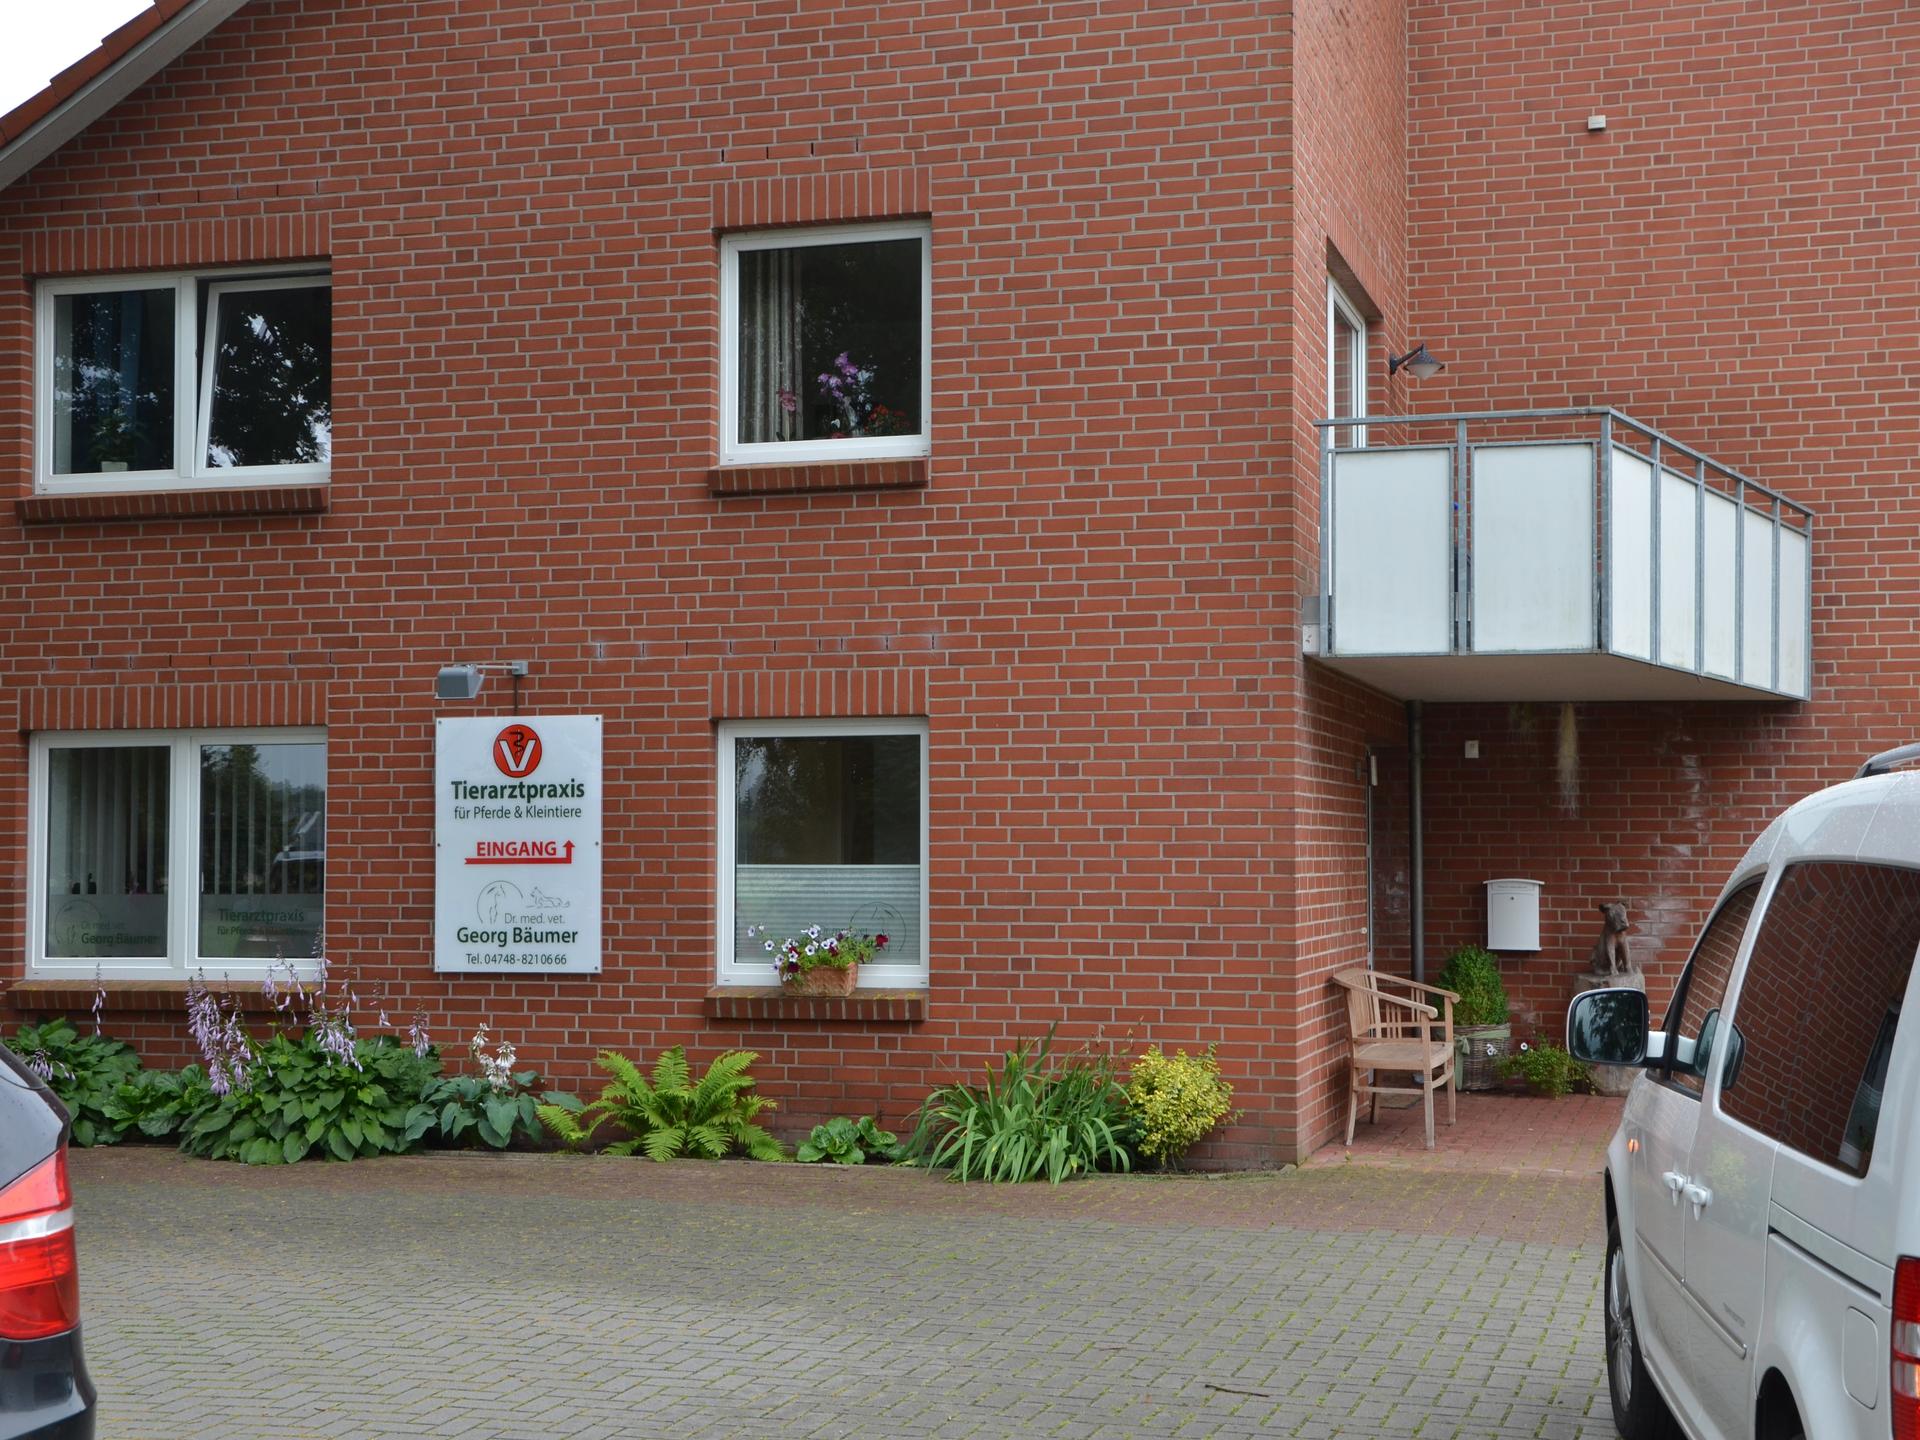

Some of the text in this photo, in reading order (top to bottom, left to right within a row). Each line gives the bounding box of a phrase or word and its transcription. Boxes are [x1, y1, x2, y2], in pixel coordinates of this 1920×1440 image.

[451, 778, 585, 804] Tierarztpraxis
[454, 805, 582, 820] für Pferde & Kleintiere
[476, 841, 557, 857] EINGANG
[504, 913, 565, 924] Dr. med. vet.
[456, 927, 578, 948] Georg Bäumer
[465, 953, 482, 965] Tel.
